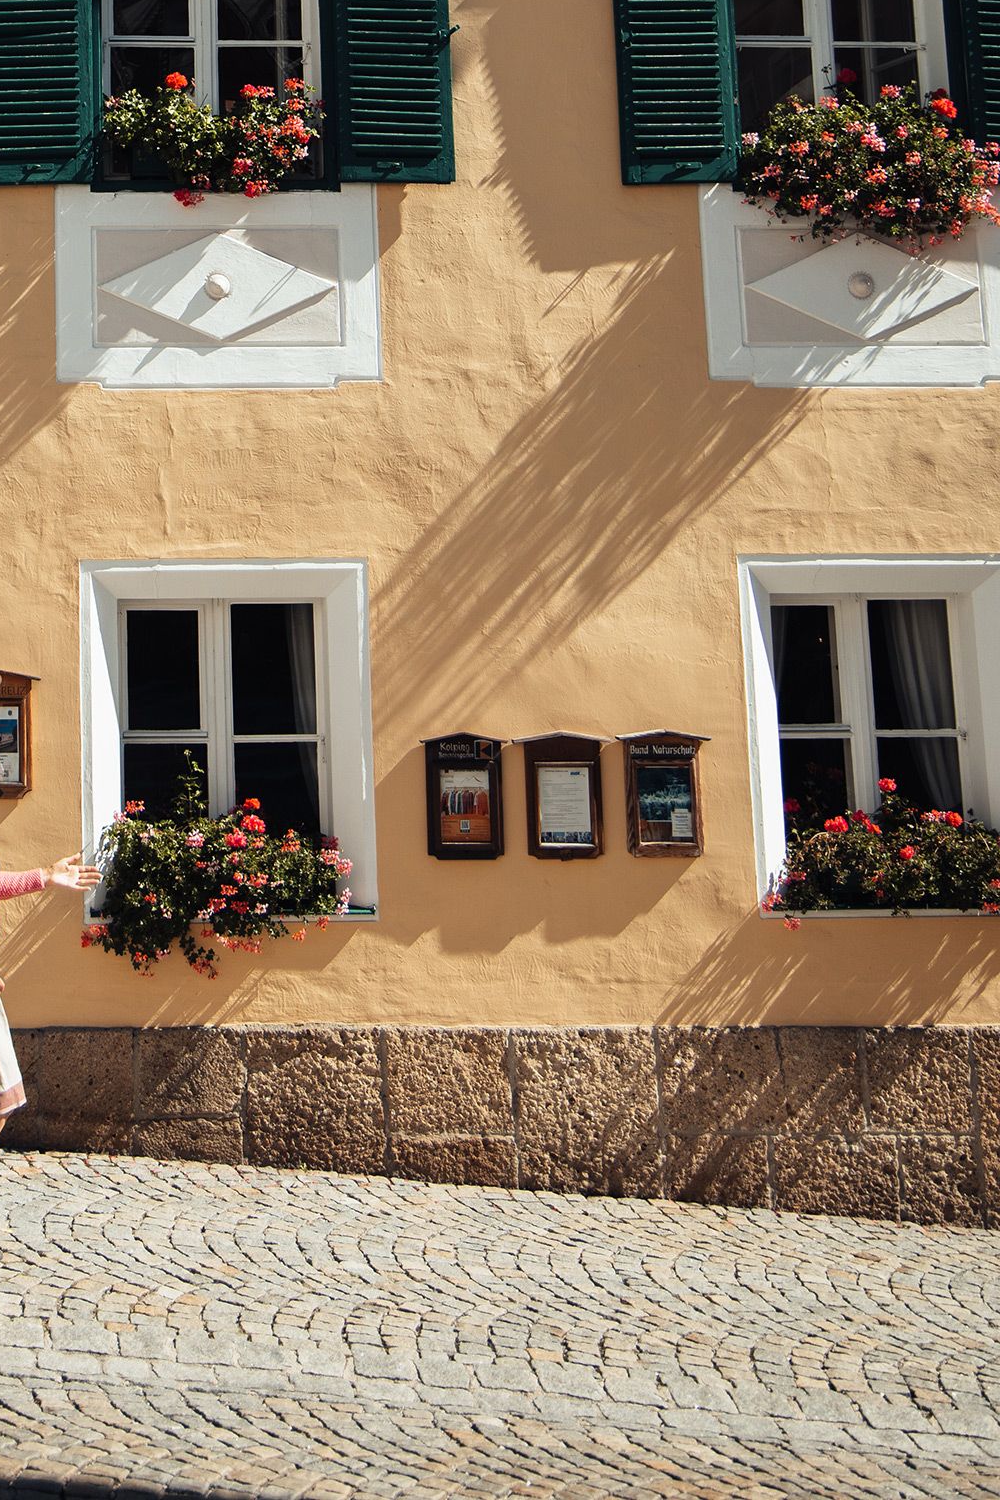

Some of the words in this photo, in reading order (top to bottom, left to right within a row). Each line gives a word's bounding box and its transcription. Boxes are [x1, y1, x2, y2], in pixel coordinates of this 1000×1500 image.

[440, 741, 470, 753] Kolping
[629, 745, 649, 755] Bund
[652, 744, 696, 756] Naturschutz
